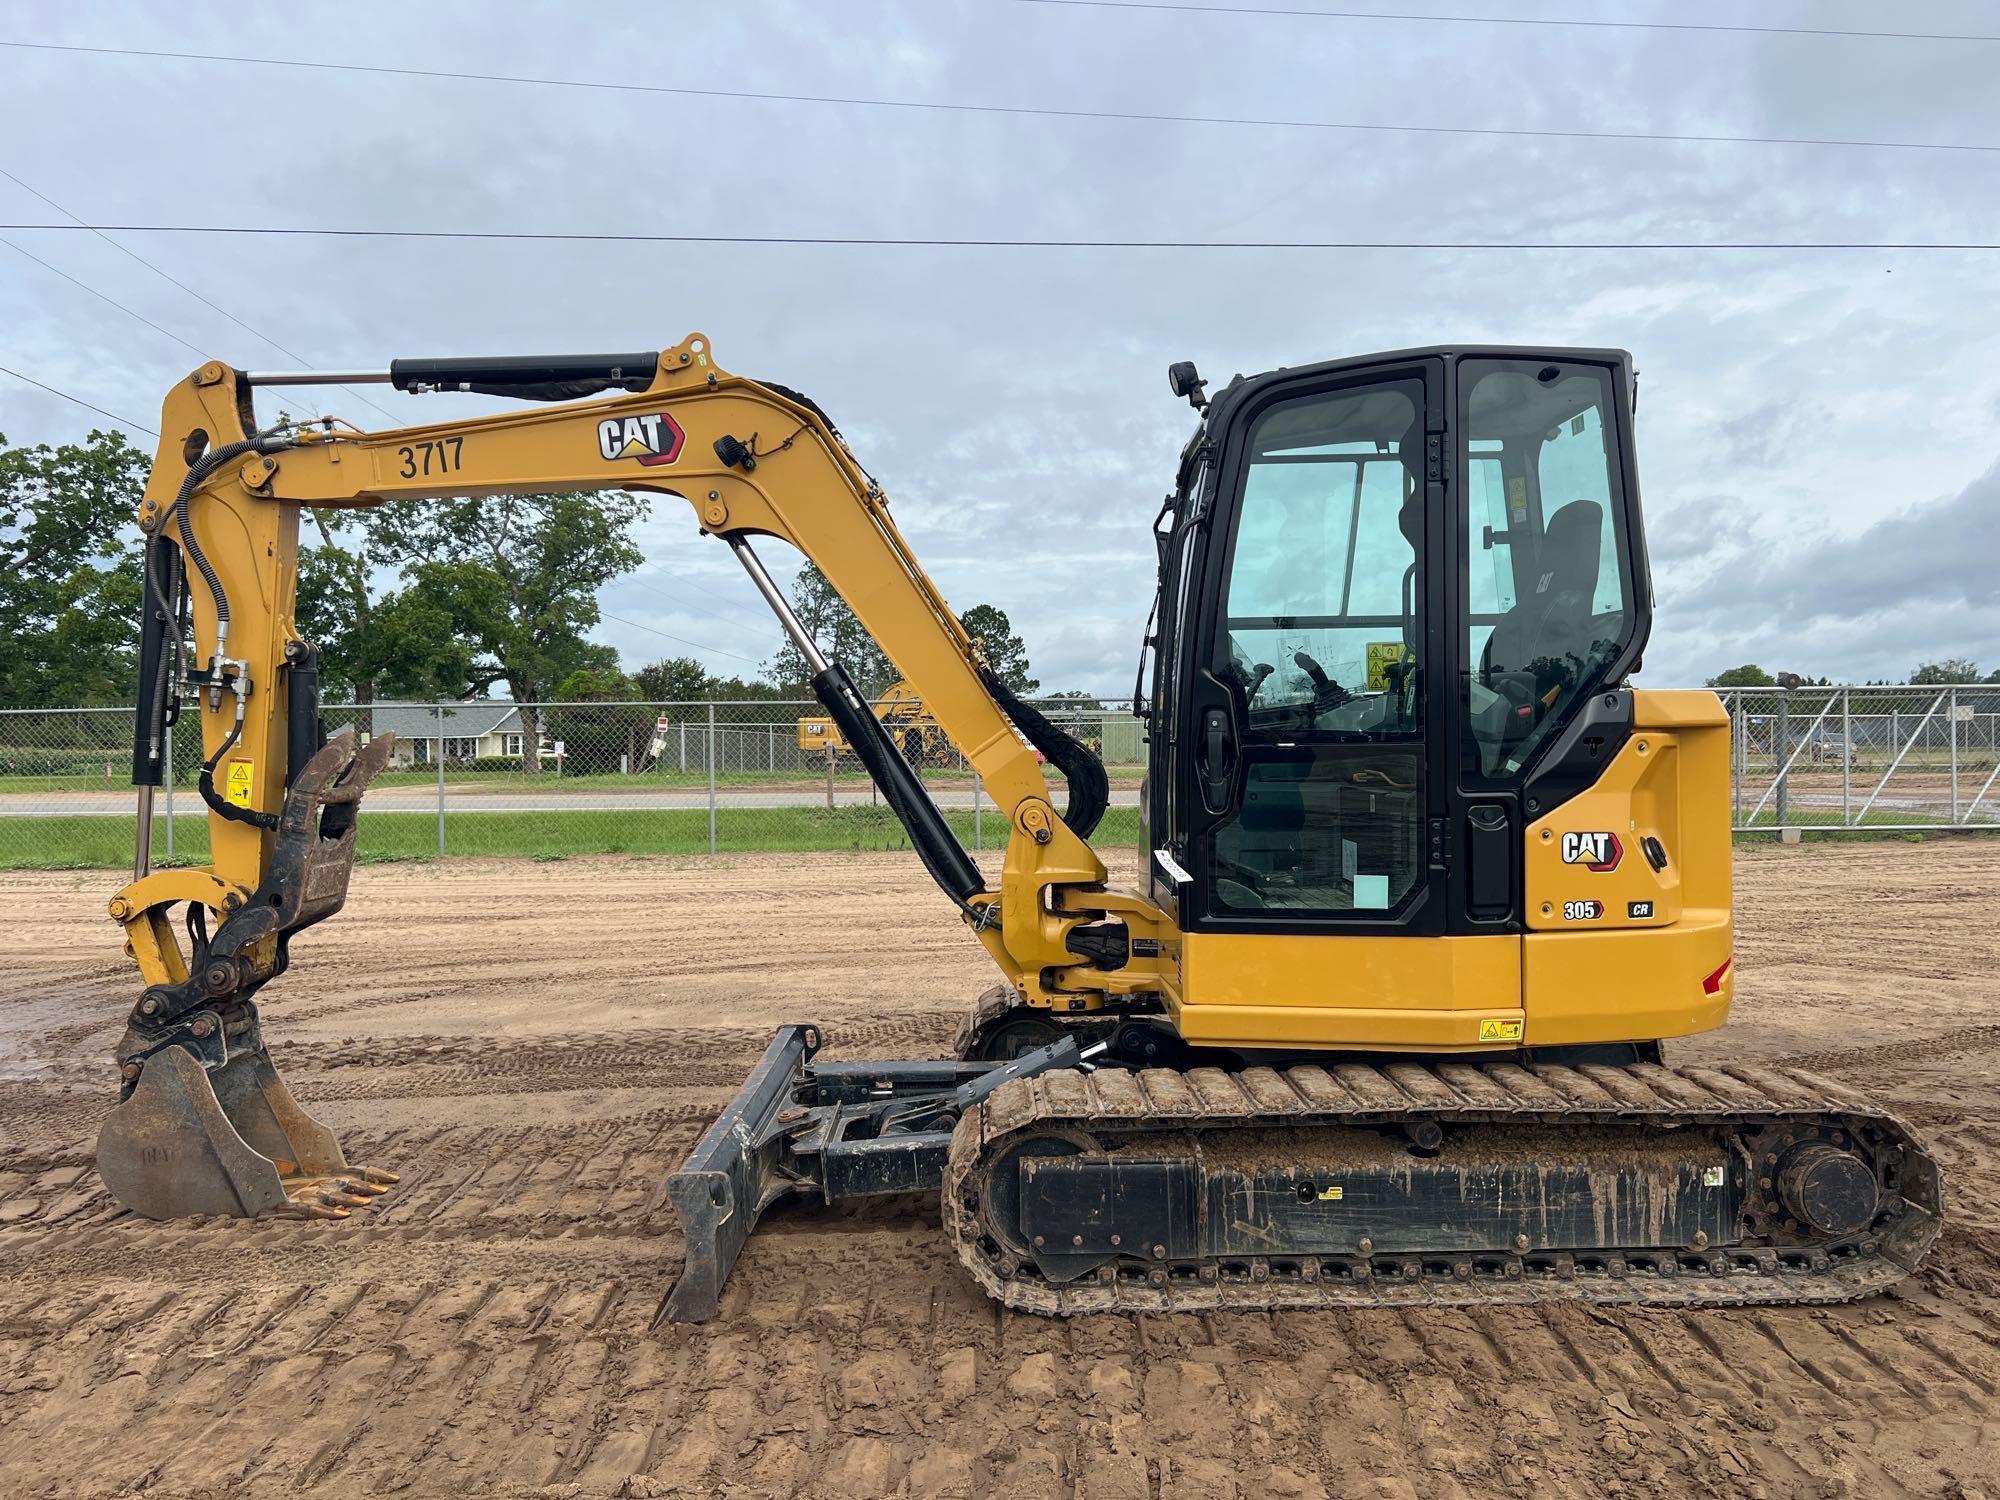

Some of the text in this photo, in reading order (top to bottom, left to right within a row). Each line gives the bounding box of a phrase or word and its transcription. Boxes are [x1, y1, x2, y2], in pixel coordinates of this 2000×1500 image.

[598, 414, 662, 459] CAT
[398, 436, 464, 479] 3717
[807, 725, 821, 734] CAT
[1562, 832, 1609, 863] CAT
[1564, 901, 1648, 919] 305 CR
